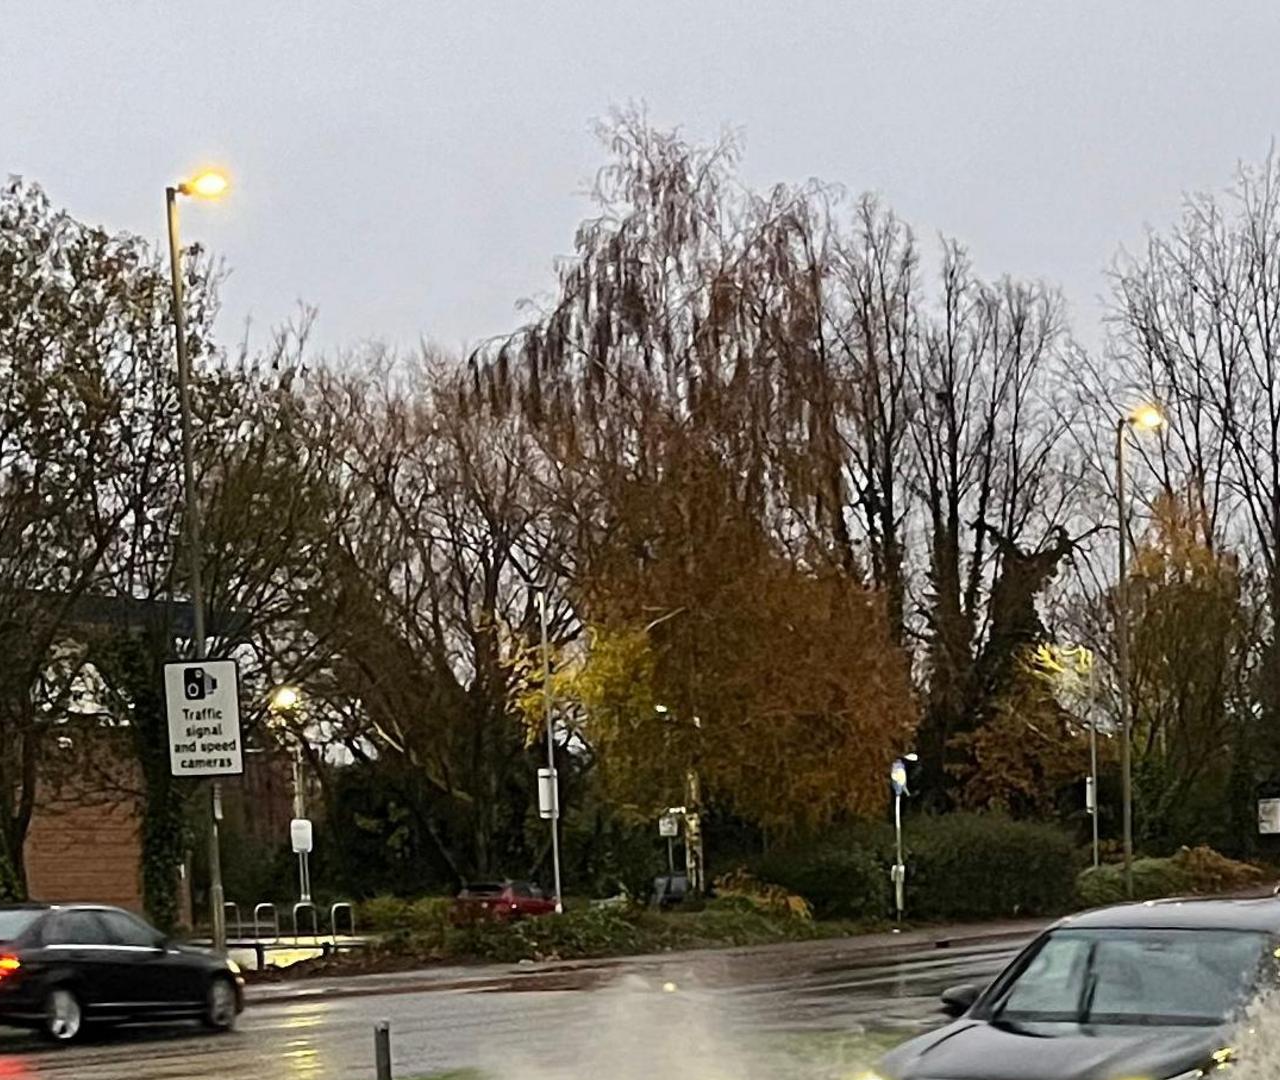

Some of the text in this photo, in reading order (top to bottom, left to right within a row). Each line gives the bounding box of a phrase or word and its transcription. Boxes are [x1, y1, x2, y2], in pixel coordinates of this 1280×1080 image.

[182, 708, 222, 720] Traffic
[186, 723, 222, 738] signal
[175, 739, 236, 754] and speed
[181, 758, 232, 768] cameras
